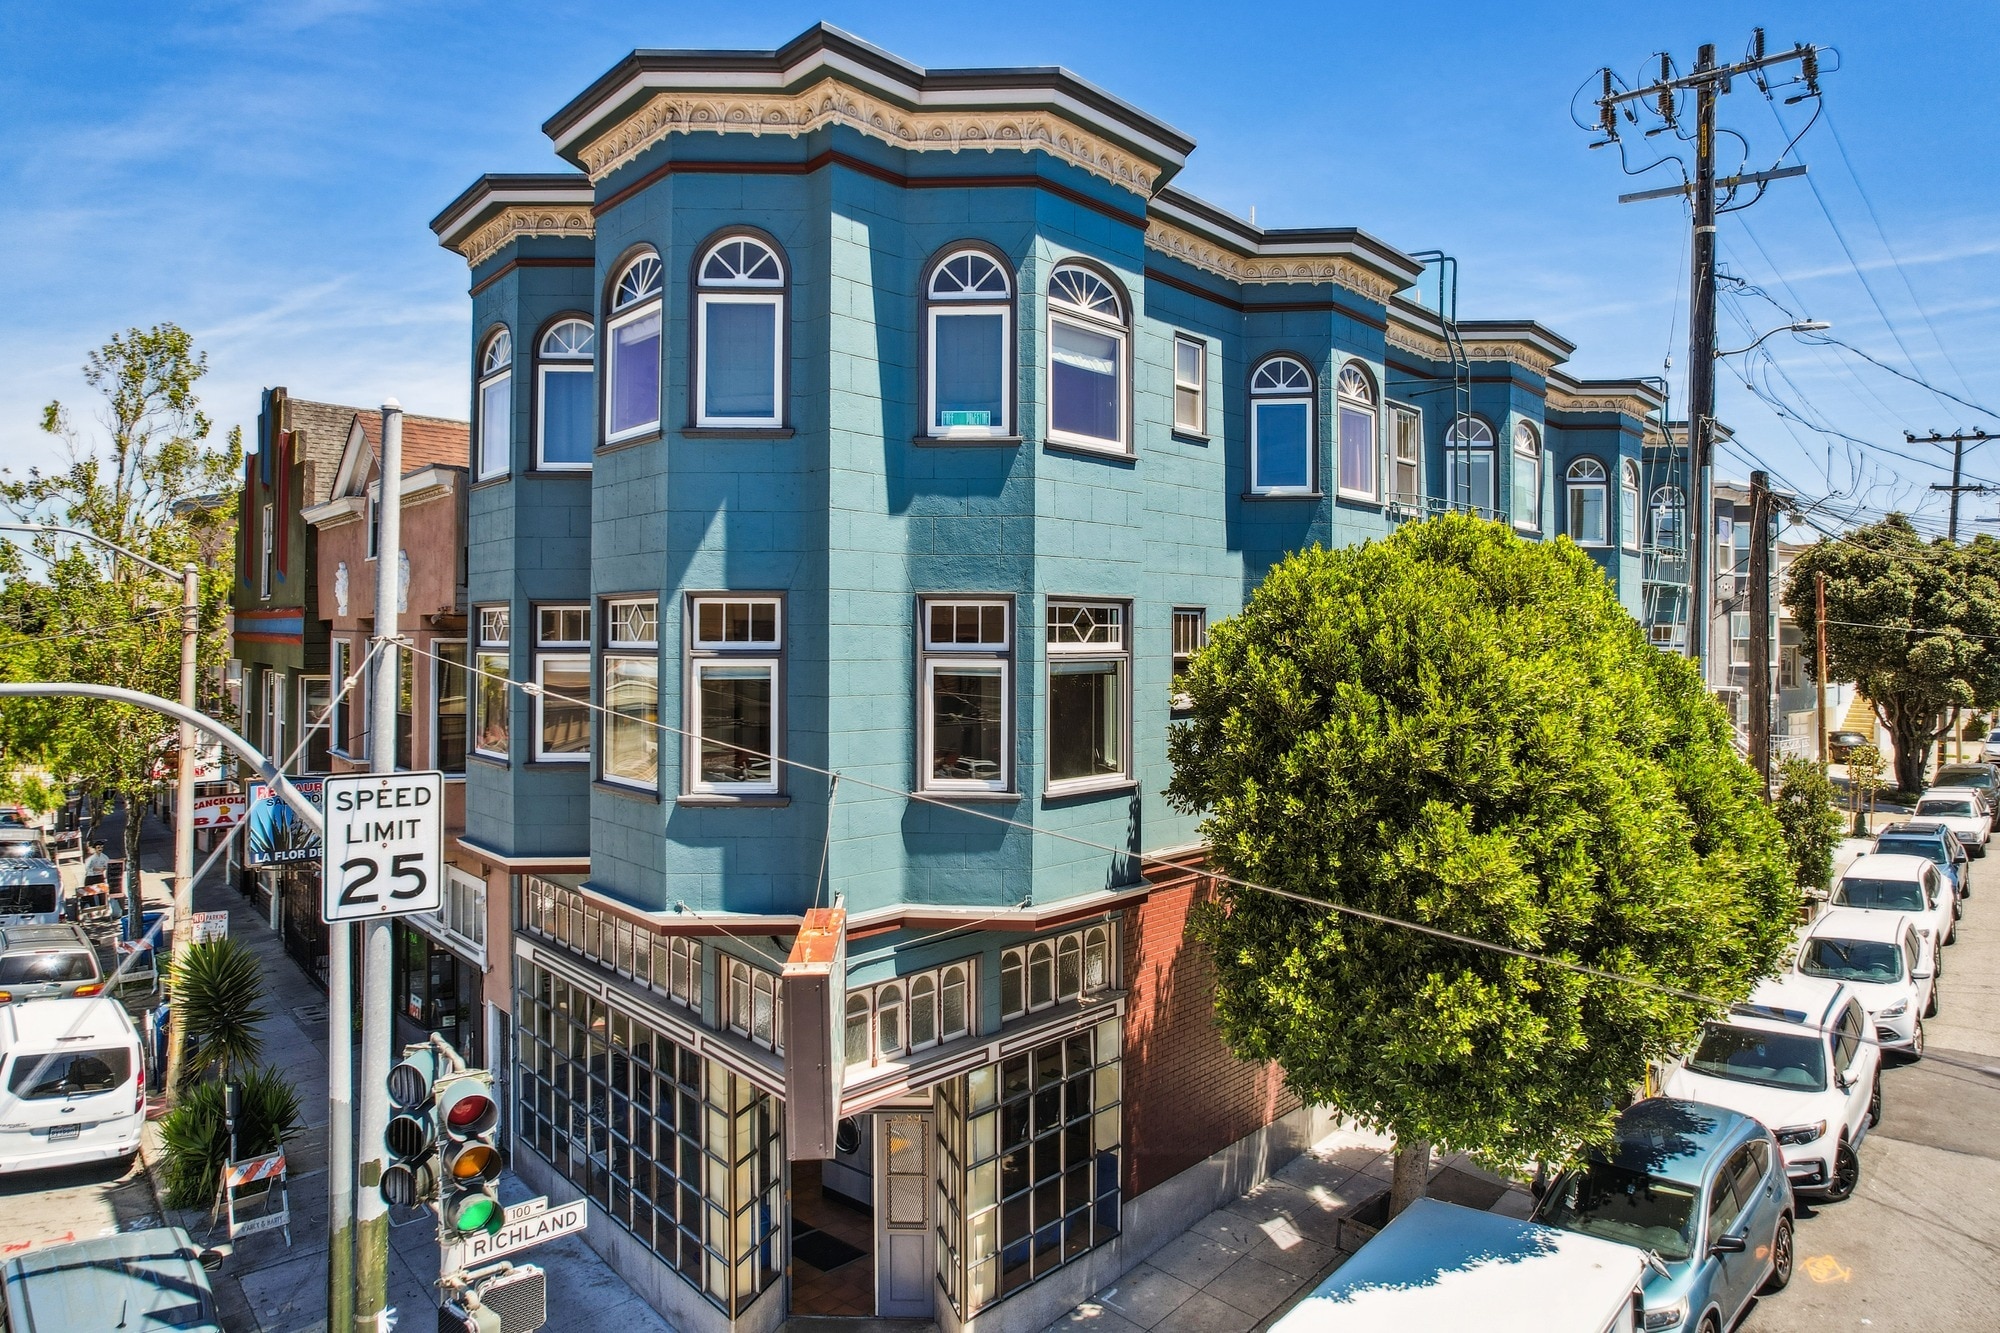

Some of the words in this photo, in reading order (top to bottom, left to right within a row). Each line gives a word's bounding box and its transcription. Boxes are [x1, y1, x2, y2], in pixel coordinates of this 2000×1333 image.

[336, 787, 431, 811] SPEED
[346, 819, 421, 844] LIMIT
[255, 852, 271, 863] LA
[274, 849, 306, 861] FLOR
[309, 848, 323, 858] DE
[339, 853, 427, 906] 25
[194, 914, 205, 923] NO
[206, 913, 227, 921] PARKING
[512, 1206, 531, 1219] 100
[473, 1211, 578, 1257] RICHLAND
